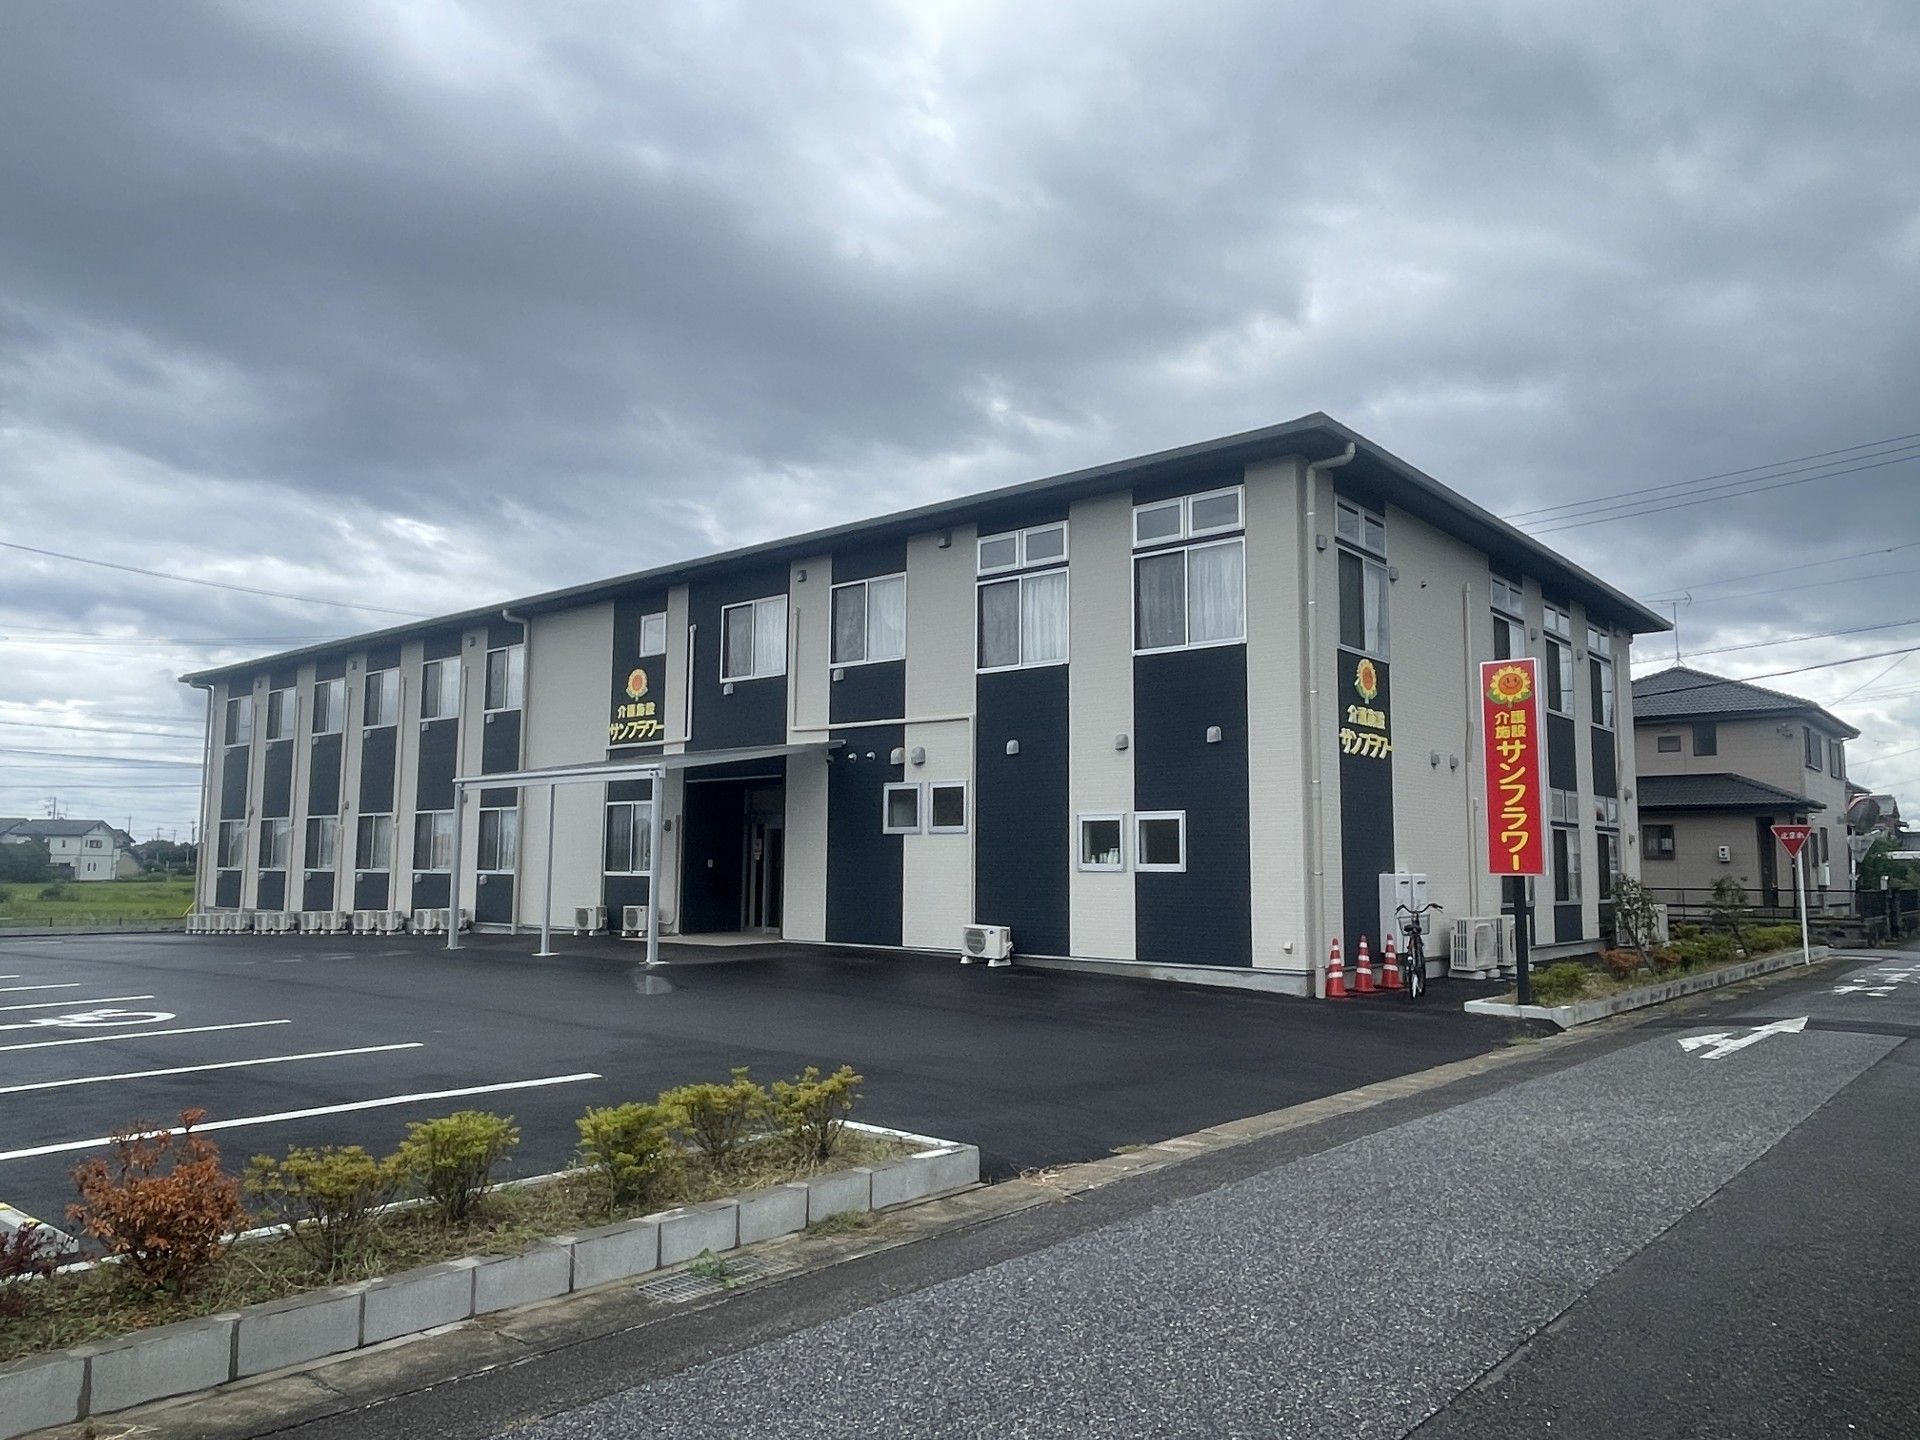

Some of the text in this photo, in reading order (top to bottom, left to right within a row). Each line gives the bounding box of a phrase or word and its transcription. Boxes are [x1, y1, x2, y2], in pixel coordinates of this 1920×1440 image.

[1496, 739, 1529, 871] サンフラワー
